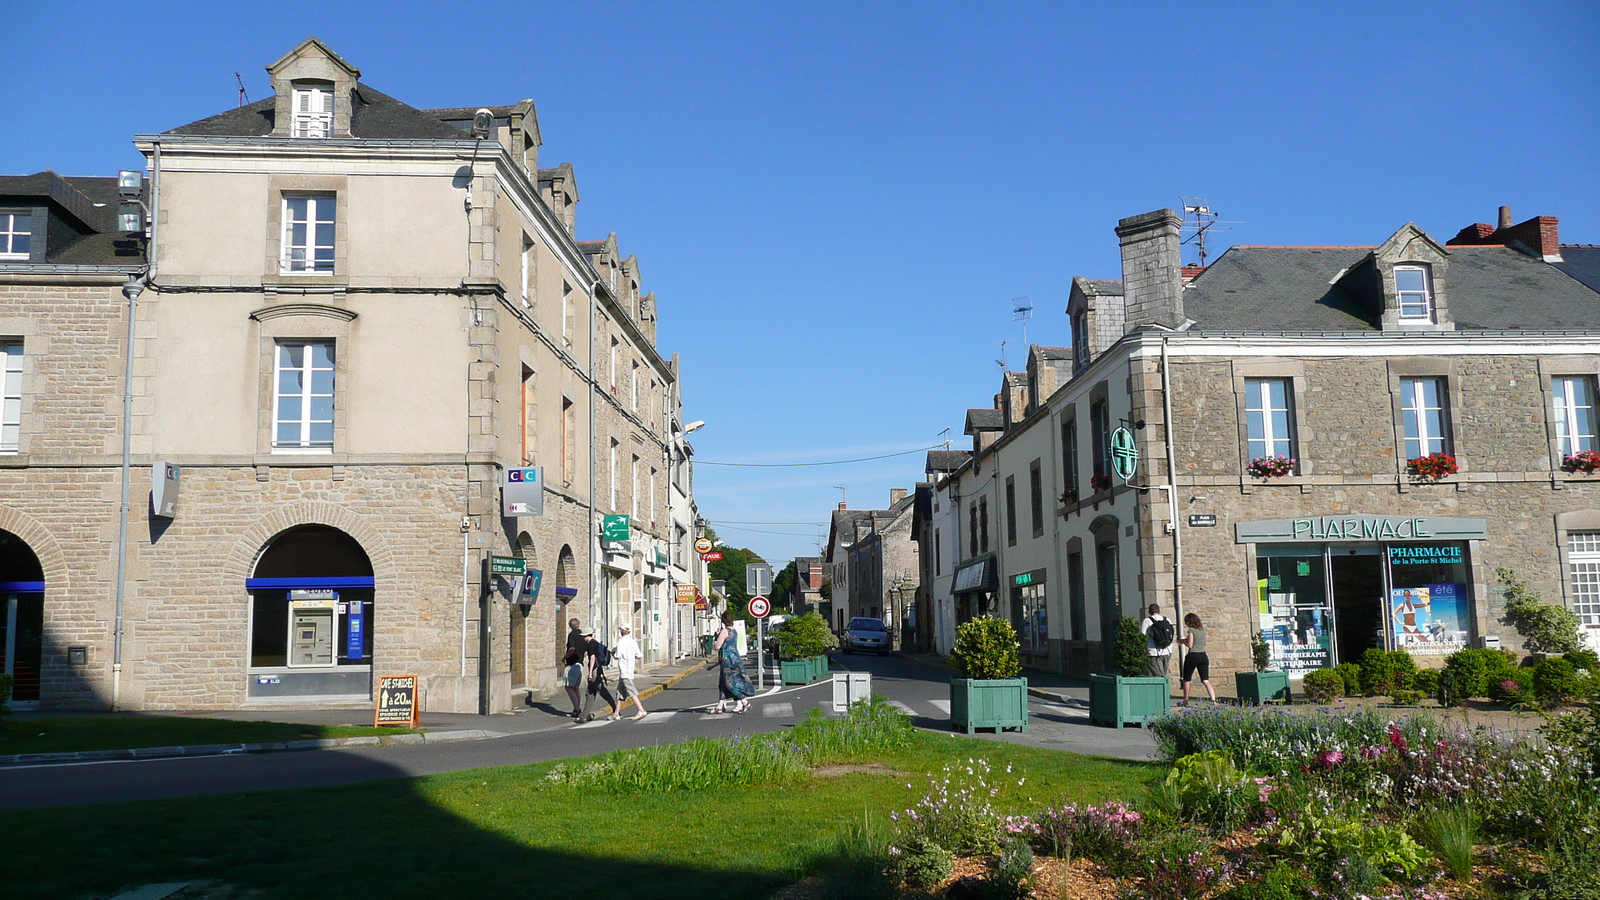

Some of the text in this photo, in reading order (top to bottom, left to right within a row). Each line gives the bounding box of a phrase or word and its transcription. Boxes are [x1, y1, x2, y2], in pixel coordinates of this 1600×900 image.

[510, 471, 533, 481] CIC
[1292, 516, 1434, 540] PHARMACIE
[1389, 546, 1462, 558] PHARMACIE
[525, 575, 539, 591] CIC
